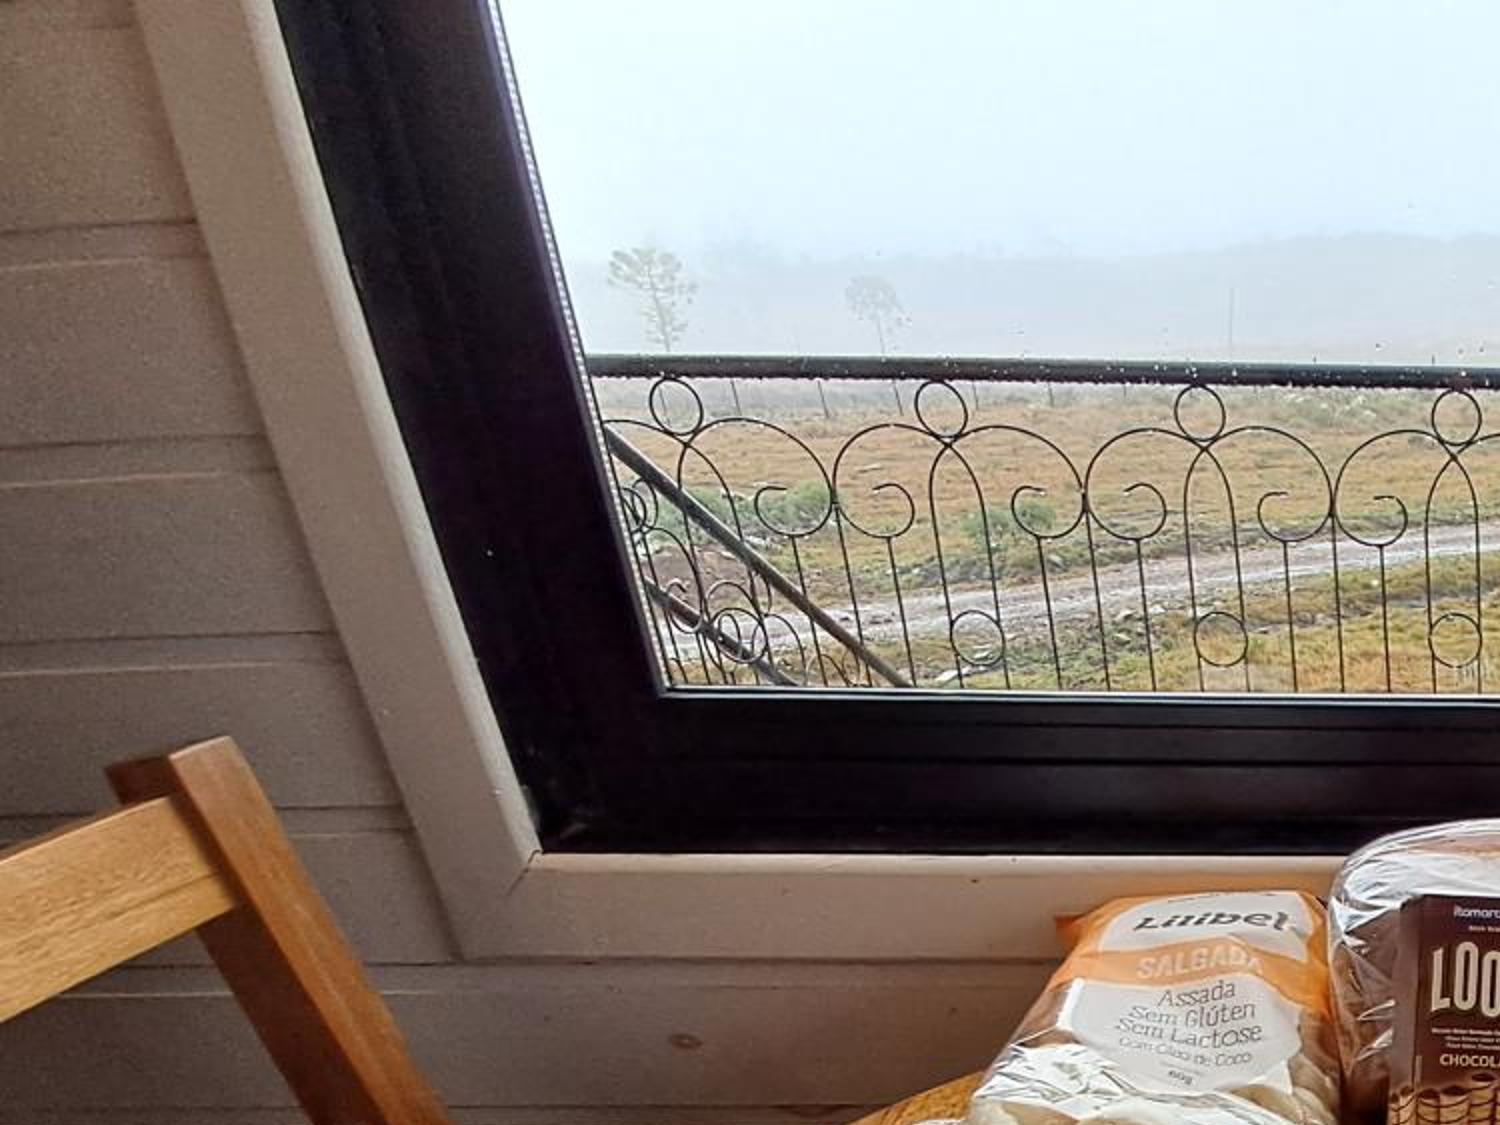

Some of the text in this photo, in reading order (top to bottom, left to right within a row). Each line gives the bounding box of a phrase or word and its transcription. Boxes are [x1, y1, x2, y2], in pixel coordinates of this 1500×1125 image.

[1136, 945, 1264, 979] SALGADA
[1157, 979, 1236, 1008] Assada
[1129, 1000, 1256, 1029] Sem Glúten
[1114, 1015, 1263, 1049] Sem Lactose
